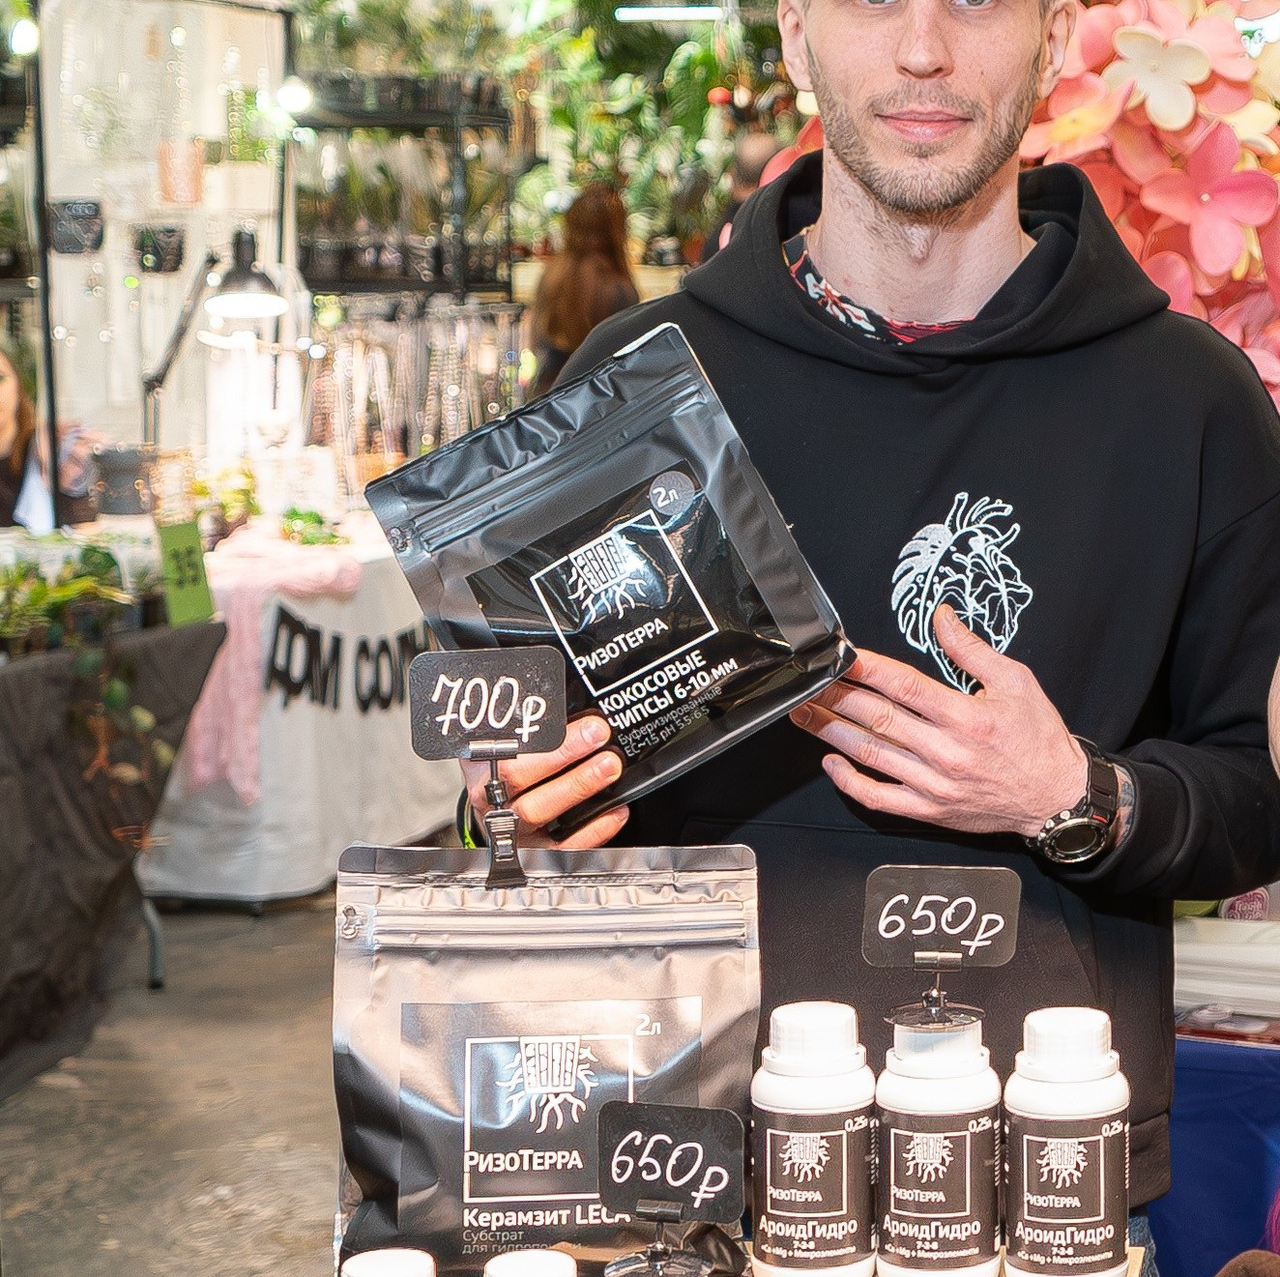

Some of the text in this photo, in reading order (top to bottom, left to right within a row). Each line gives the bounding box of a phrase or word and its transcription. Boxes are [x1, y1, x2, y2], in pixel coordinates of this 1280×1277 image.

[652, 485, 679, 507] 2л
[598, 649, 707, 716] КОКОСОВЫЕ
[607, 657, 739, 731] ЧИПСЫ 6-10 мм
[618, 686, 722, 746] Буферизированные
[634, 1013, 662, 1036] 2л
[462, 1207, 573, 1231] Керамзит
[759, 1214, 858, 1240] АроидГидро
[883, 1214, 982, 1241] АроидГидро
[462, 1229, 525, 1245] Субстрат
[1015, 1221, 1115, 1247] АроидГидро
